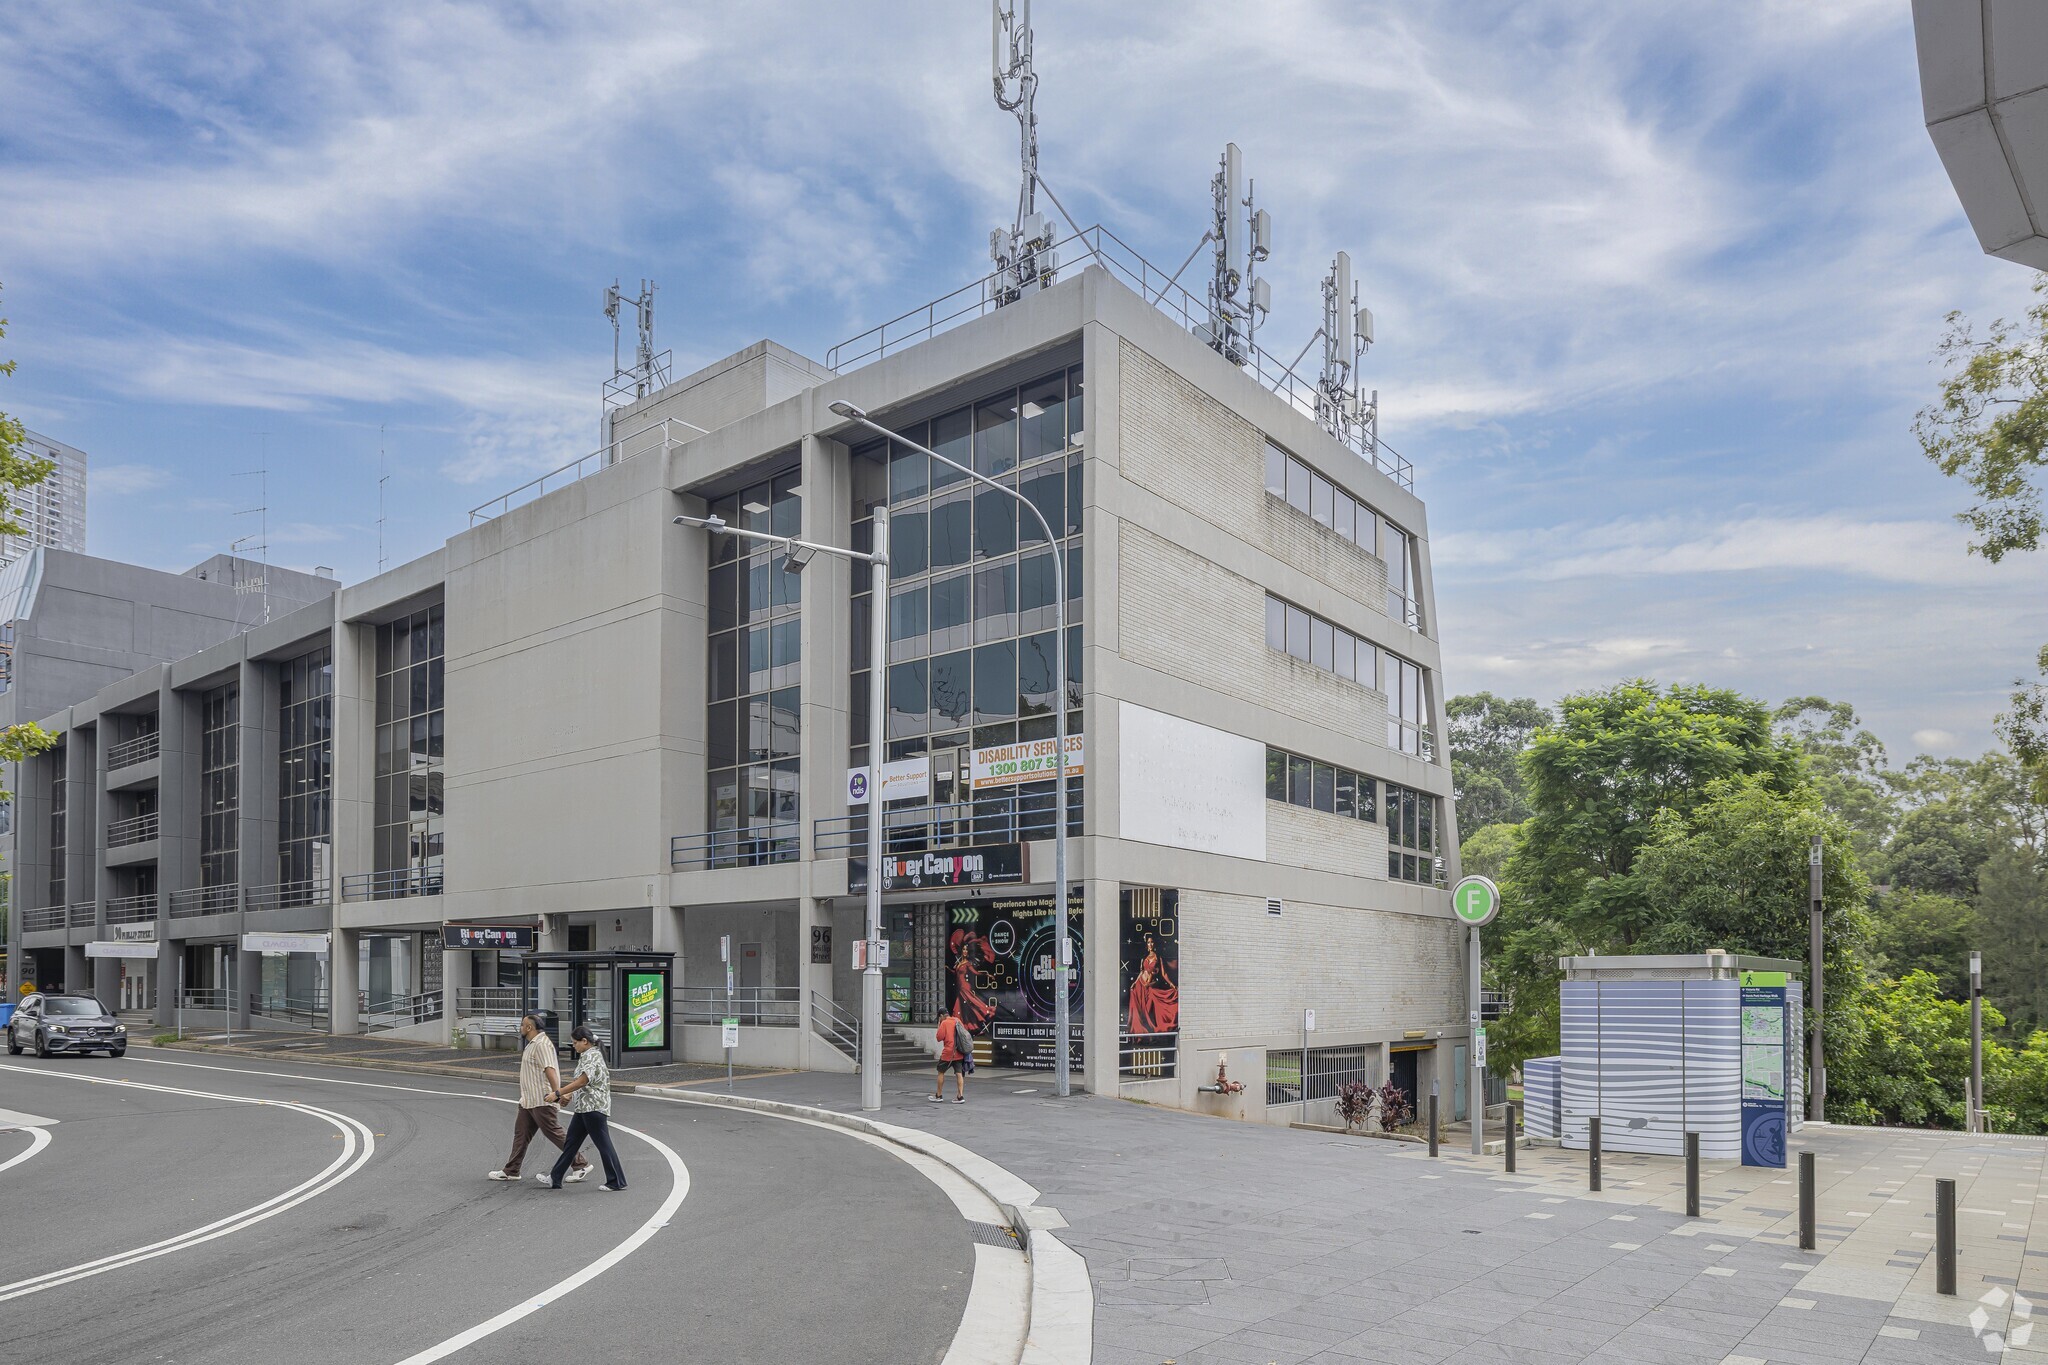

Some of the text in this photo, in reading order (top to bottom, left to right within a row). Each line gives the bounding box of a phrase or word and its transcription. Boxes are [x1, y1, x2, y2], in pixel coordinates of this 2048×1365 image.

[978, 736, 1083, 765] DISABILITY SERVCES
[988, 761, 1018, 776] 1300
[1020, 757, 1043, 771] 807
[889, 775, 906, 783] Better
[906, 770, 928, 782] Support
[852, 785, 865, 795] ndis
[883, 853, 984, 884] River Canyon
[992, 900, 1026, 910] Experience
[1027, 899, 1038, 907] the
[1467, 889, 1481, 914] F
[1012, 909, 1034, 920] Nights
[1034, 908, 1047, 917] Like
[460, 928, 517, 944] River Canyon
[813, 929, 831, 944] 96
[21, 967, 35, 975] 90
[632, 982, 653, 998] FAST
[997, 1027, 1013, 1035] BUFFET
[1013, 1028, 1026, 1036] MENU
[1030, 1028, 1046, 1036] LUNCH
